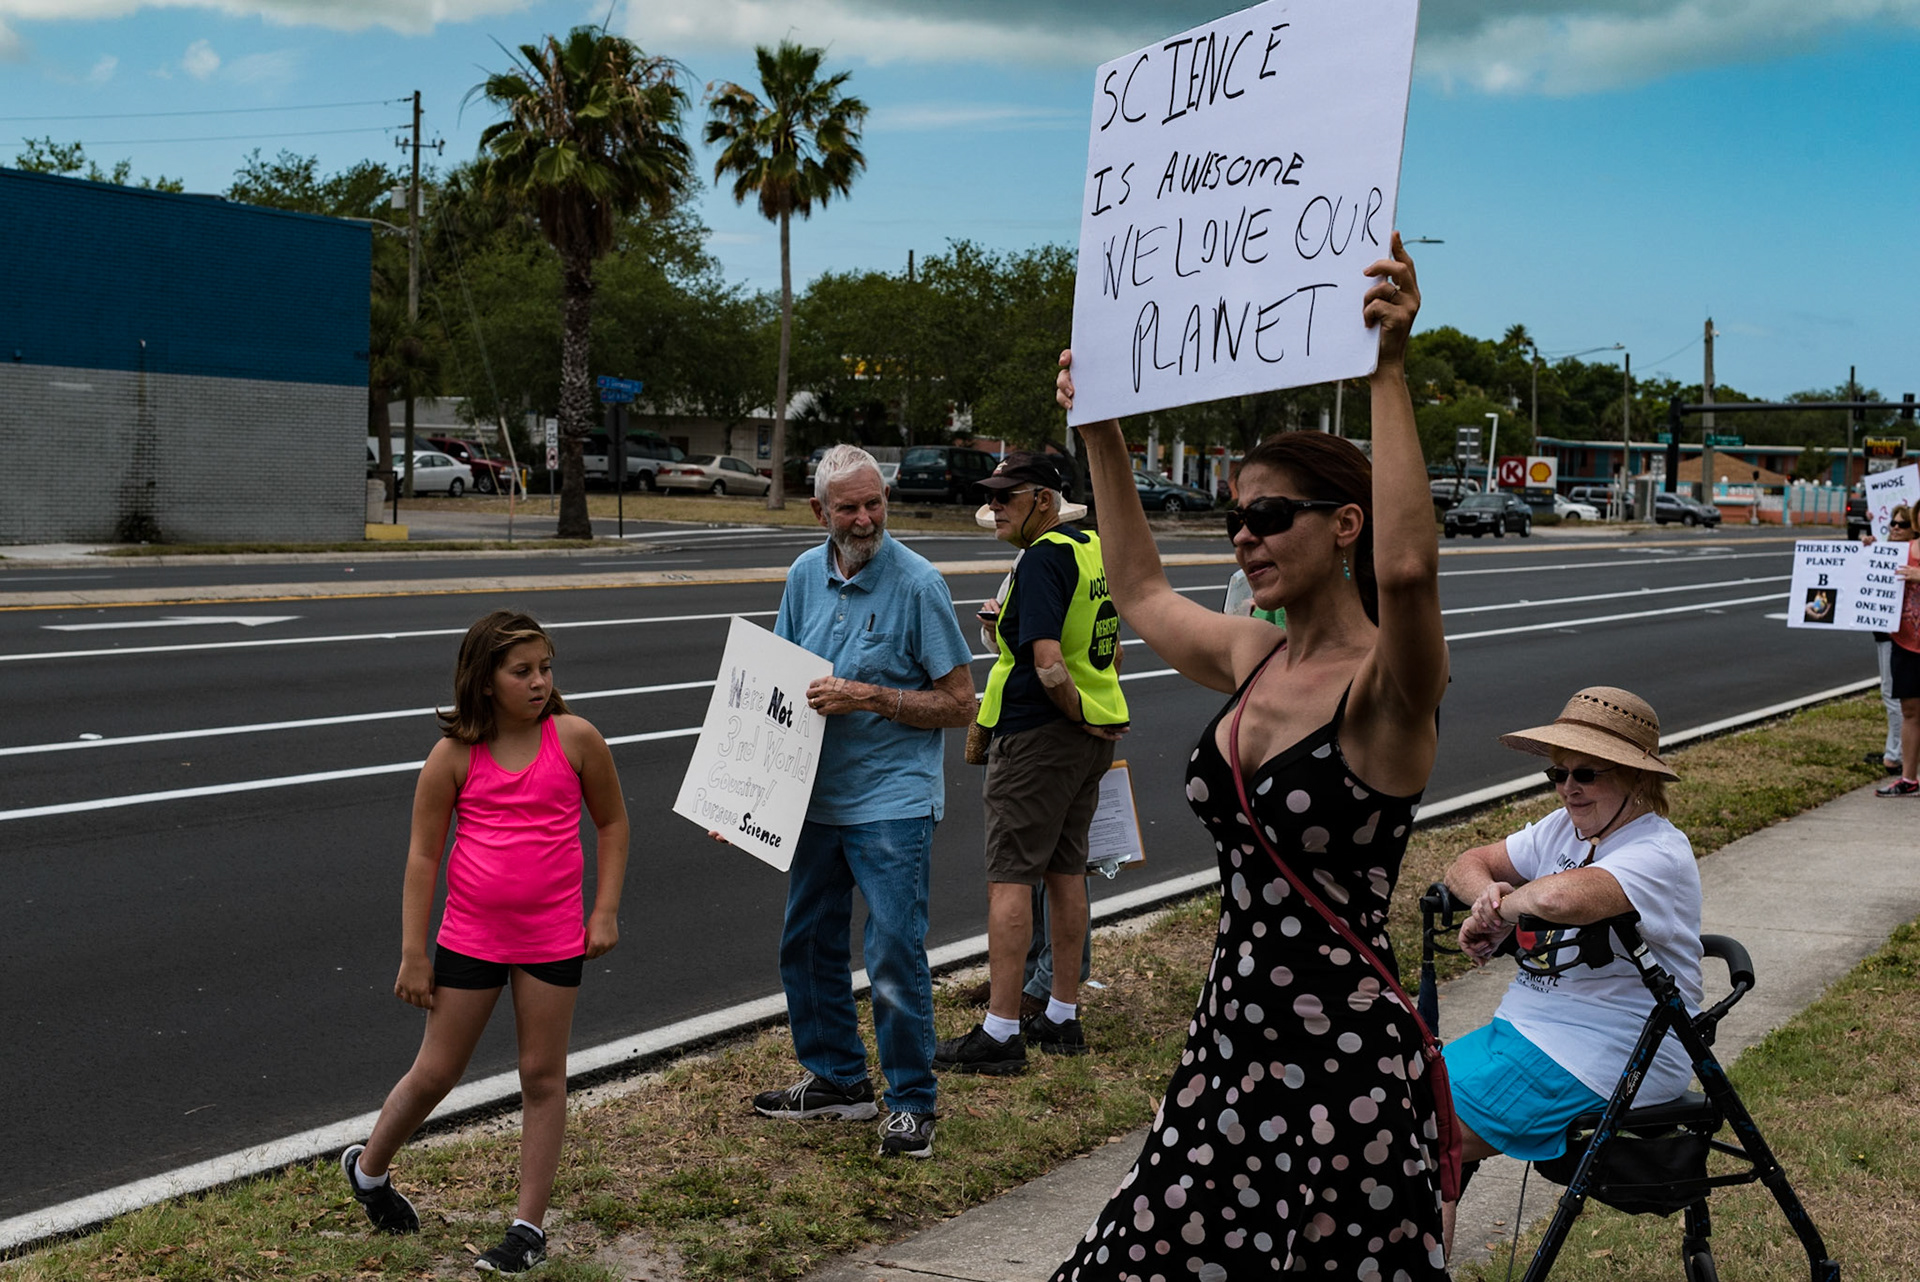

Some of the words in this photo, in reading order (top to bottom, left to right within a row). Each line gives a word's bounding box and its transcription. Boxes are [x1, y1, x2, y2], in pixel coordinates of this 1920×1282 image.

[1101, 23, 1290, 131] SCIENCE
[1091, 162, 1134, 216] IS
[1157, 151, 1305, 199] AWESOME
[1103, 224, 1168, 299] WE
[1175, 206, 1272, 277] LOVE
[1295, 187, 1383, 260] OUR
[1132, 283, 1338, 392] PLANET
[1871, 475, 1905, 490] WHOSE
[1797, 544, 1830, 553] THERE
[1831, 545, 1842, 553] IS
[1843, 545, 1859, 554] NO
[1873, 546, 1899, 556] LETS
[1806, 557, 1846, 566] PLANET
[1869, 559, 1898, 570] TAKE
[1817, 573, 1829, 586] B
[1866, 573, 1895, 584] CARE
[1860, 587, 1874, 596] OF
[1875, 589, 1897, 599] THE
[1855, 600, 1877, 611] ONE
[1879, 602, 1896, 614] WE
[1856, 615, 1889, 627] HAVE!
[1098, 637, 1113, 656] HERE
[767, 686, 793, 728] Not
[796, 704, 810, 738] A
[718, 715, 760, 762] 3rd
[763, 731, 812, 783] World
[708, 761, 778, 813] Country!
[692, 787, 738, 825] Pursue
[739, 812, 782, 848] Science
